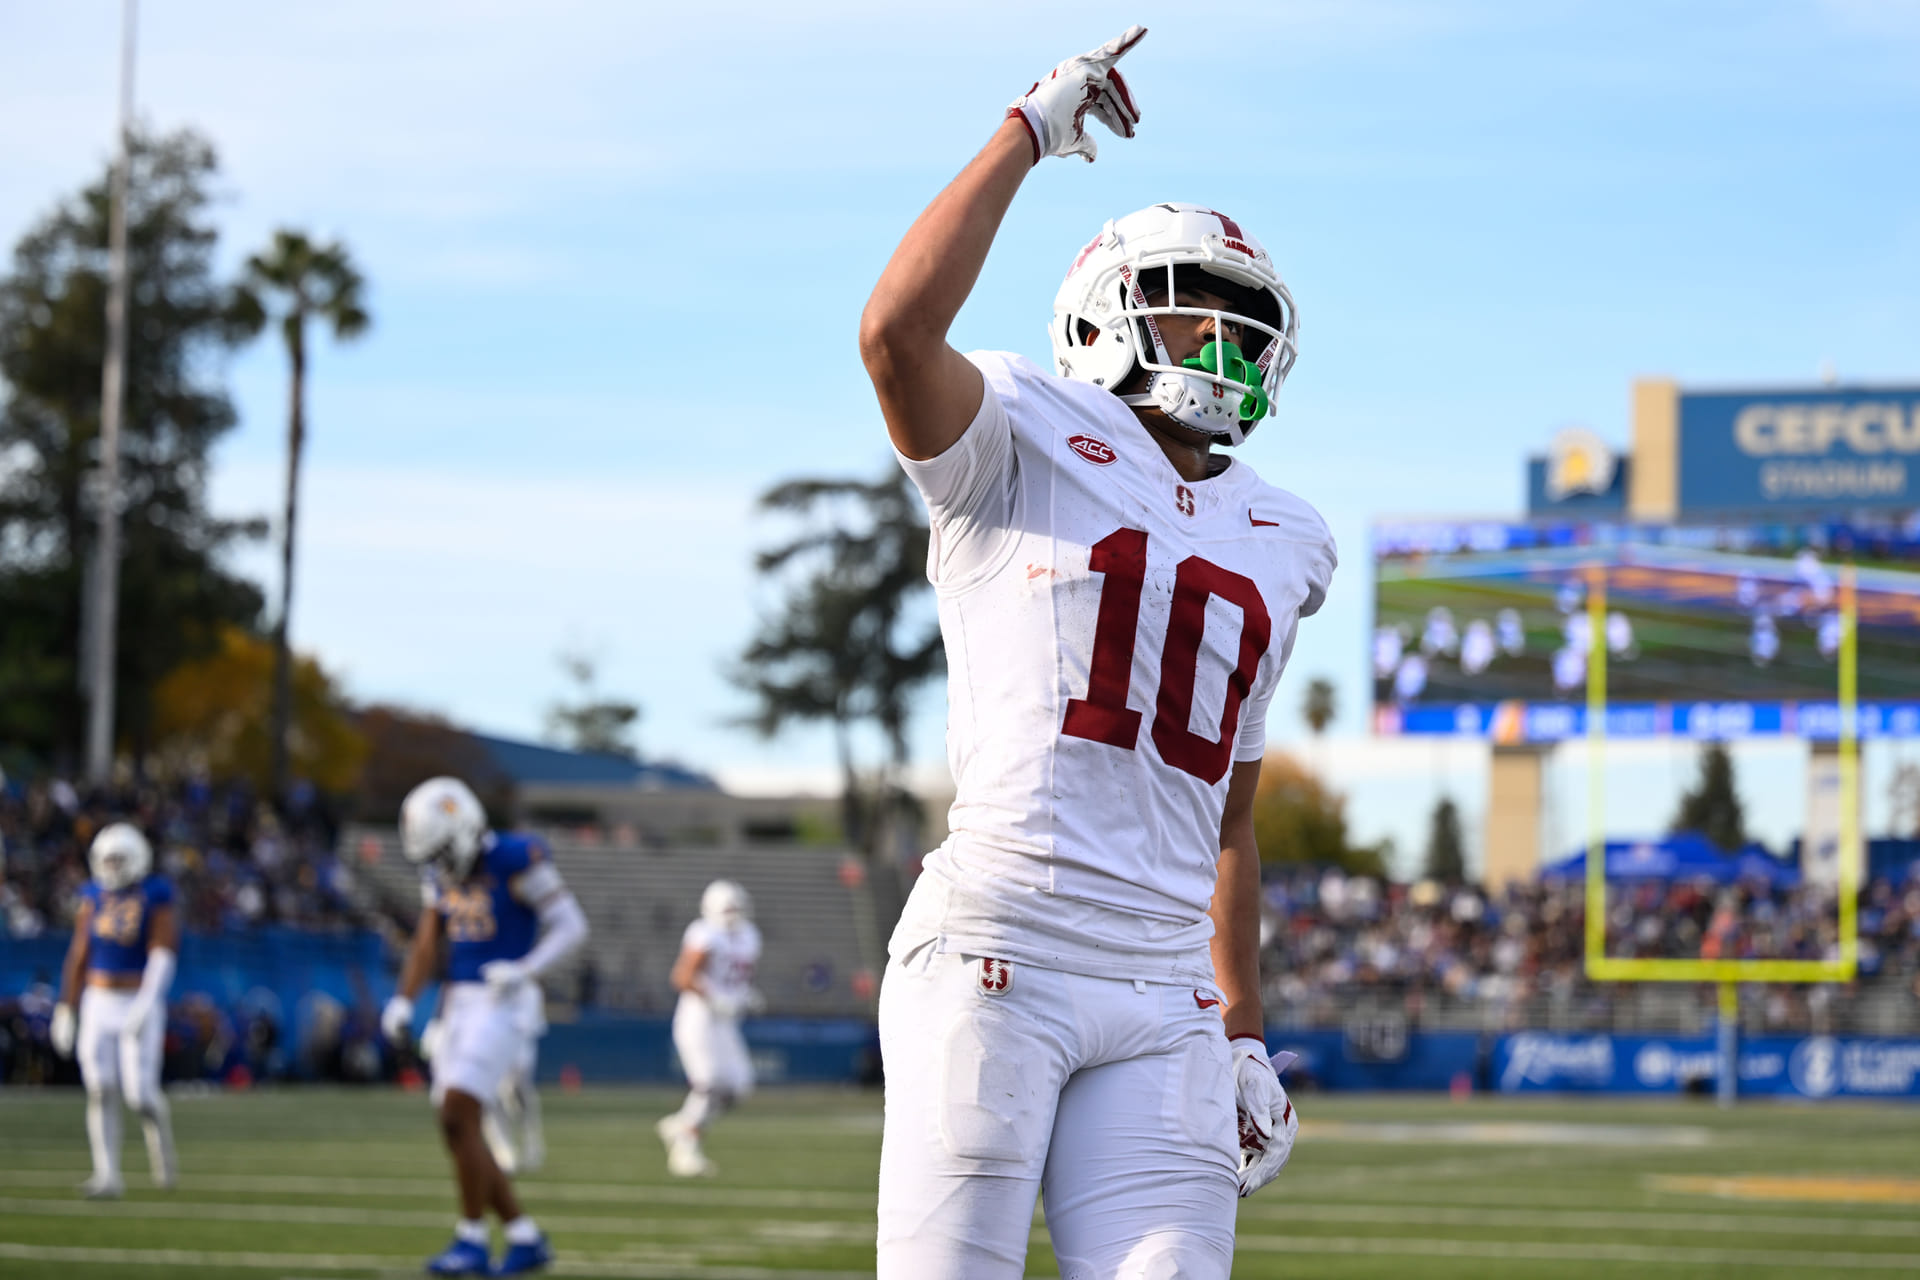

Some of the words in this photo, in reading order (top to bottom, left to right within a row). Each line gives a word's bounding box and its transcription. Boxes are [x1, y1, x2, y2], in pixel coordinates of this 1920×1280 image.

[1073, 440, 1111, 459] ACC
[1734, 403, 1920, 455] CEFCU
[1759, 463, 1906, 498] STADIUM
[1061, 526, 1271, 786] 10
